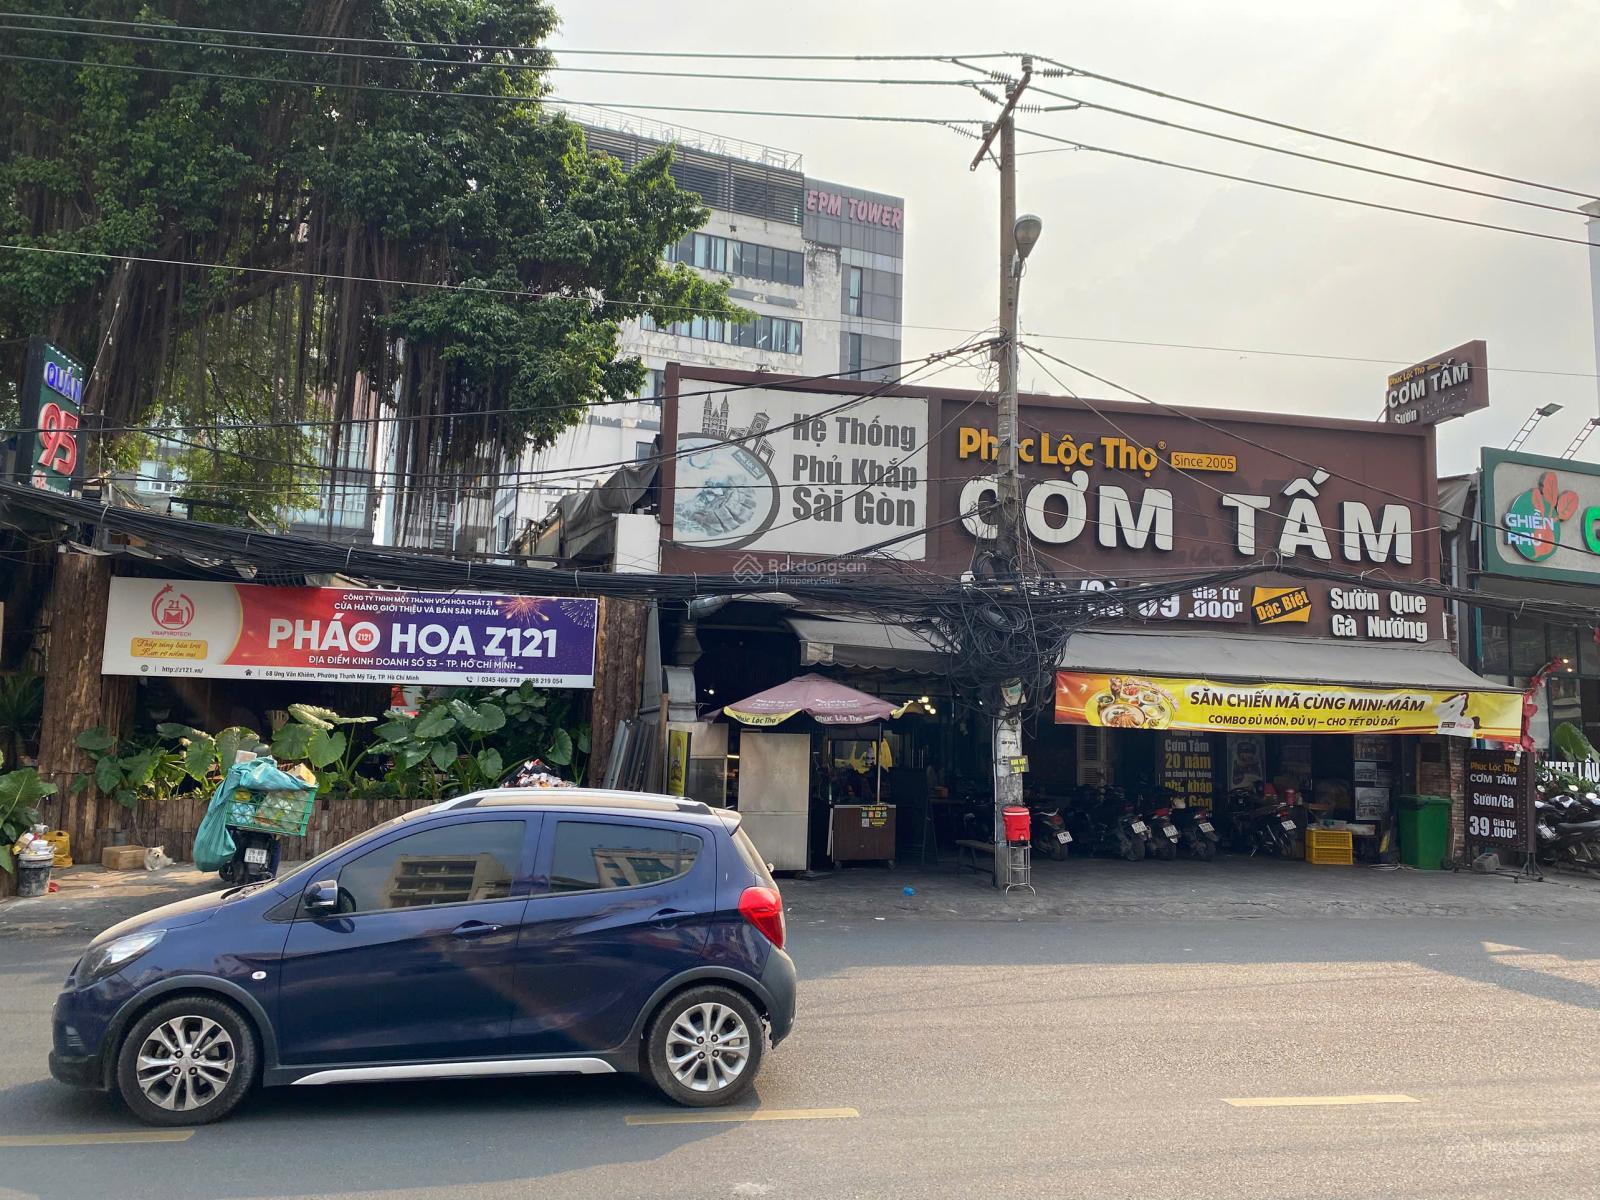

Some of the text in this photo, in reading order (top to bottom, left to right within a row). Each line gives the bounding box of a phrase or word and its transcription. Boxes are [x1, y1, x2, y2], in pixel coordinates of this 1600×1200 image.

[807, 190, 904, 230] EPM TOWER
[44, 361, 82, 406] QUÁN
[1388, 357, 1469, 408] CƠM TẤM
[38, 403, 78, 475] 95
[793, 413, 916, 451] Hệ Thống
[960, 427, 1158, 477] Phc Lộc Thọ
[1174, 455, 1234, 469] Since 2005
[792, 454, 842, 485] Phủ
[852, 458, 917, 491] Khắp
[792, 487, 916, 527] Sài Gòn
[960, 467, 1412, 565] CƠM TẤM
[1507, 531, 1542, 547] RAU
[343, 593, 363, 601] CÔNG
[394, 595, 409, 603] MỘT
[1192, 587, 1217, 600] Gia
[1281, 590, 1309, 610] Biệt
[1330, 587, 1427, 614] Sườn Que
[169, 600, 179, 608] 21
[335, 601, 499, 616] CỬA HÀNG GIỚI THIỆU VÀ BÁN SẢN PHẨM
[268, 613, 557, 658] PHÁO HOA Z121
[357, 633, 371, 641] Z121
[1332, 614, 1428, 642] Gà Nướng
[309, 655, 324, 666] ĐỊA
[327, 654, 350, 664] ĐIỂM
[352, 657, 373, 665] KINH
[376, 657, 409, 667] DOANH
[411, 656, 424, 667] SỐ
[427, 659, 437, 667] 53
[460, 657, 474, 668] HỒ
[476, 659, 492, 669] CHÍ
[1190, 688, 1425, 711] SĂN CHIẾN MÃ CÙNG MINI-MÂM
[1209, 714, 1246, 725] COMBO
[1248, 713, 1263, 725] ĐỦ
[1264, 714, 1288, 726] MÓN,
[1291, 714, 1305, 725] ĐỦ
[1308, 716, 1317, 728] VỊ
[1327, 717, 1346, 726] CHO
[1349, 716, 1365, 726] TẾT
[1366, 715, 1379, 726] ĐỦ
[1165, 739, 1187, 752] Cơm
[1166, 753, 1180, 768] 20
[1470, 773, 1492, 784] CƠM
[1473, 792, 1514, 809] Sườn/Gà
[1470, 816, 1490, 837] 39
[1493, 818, 1515, 828] Gia Từ
